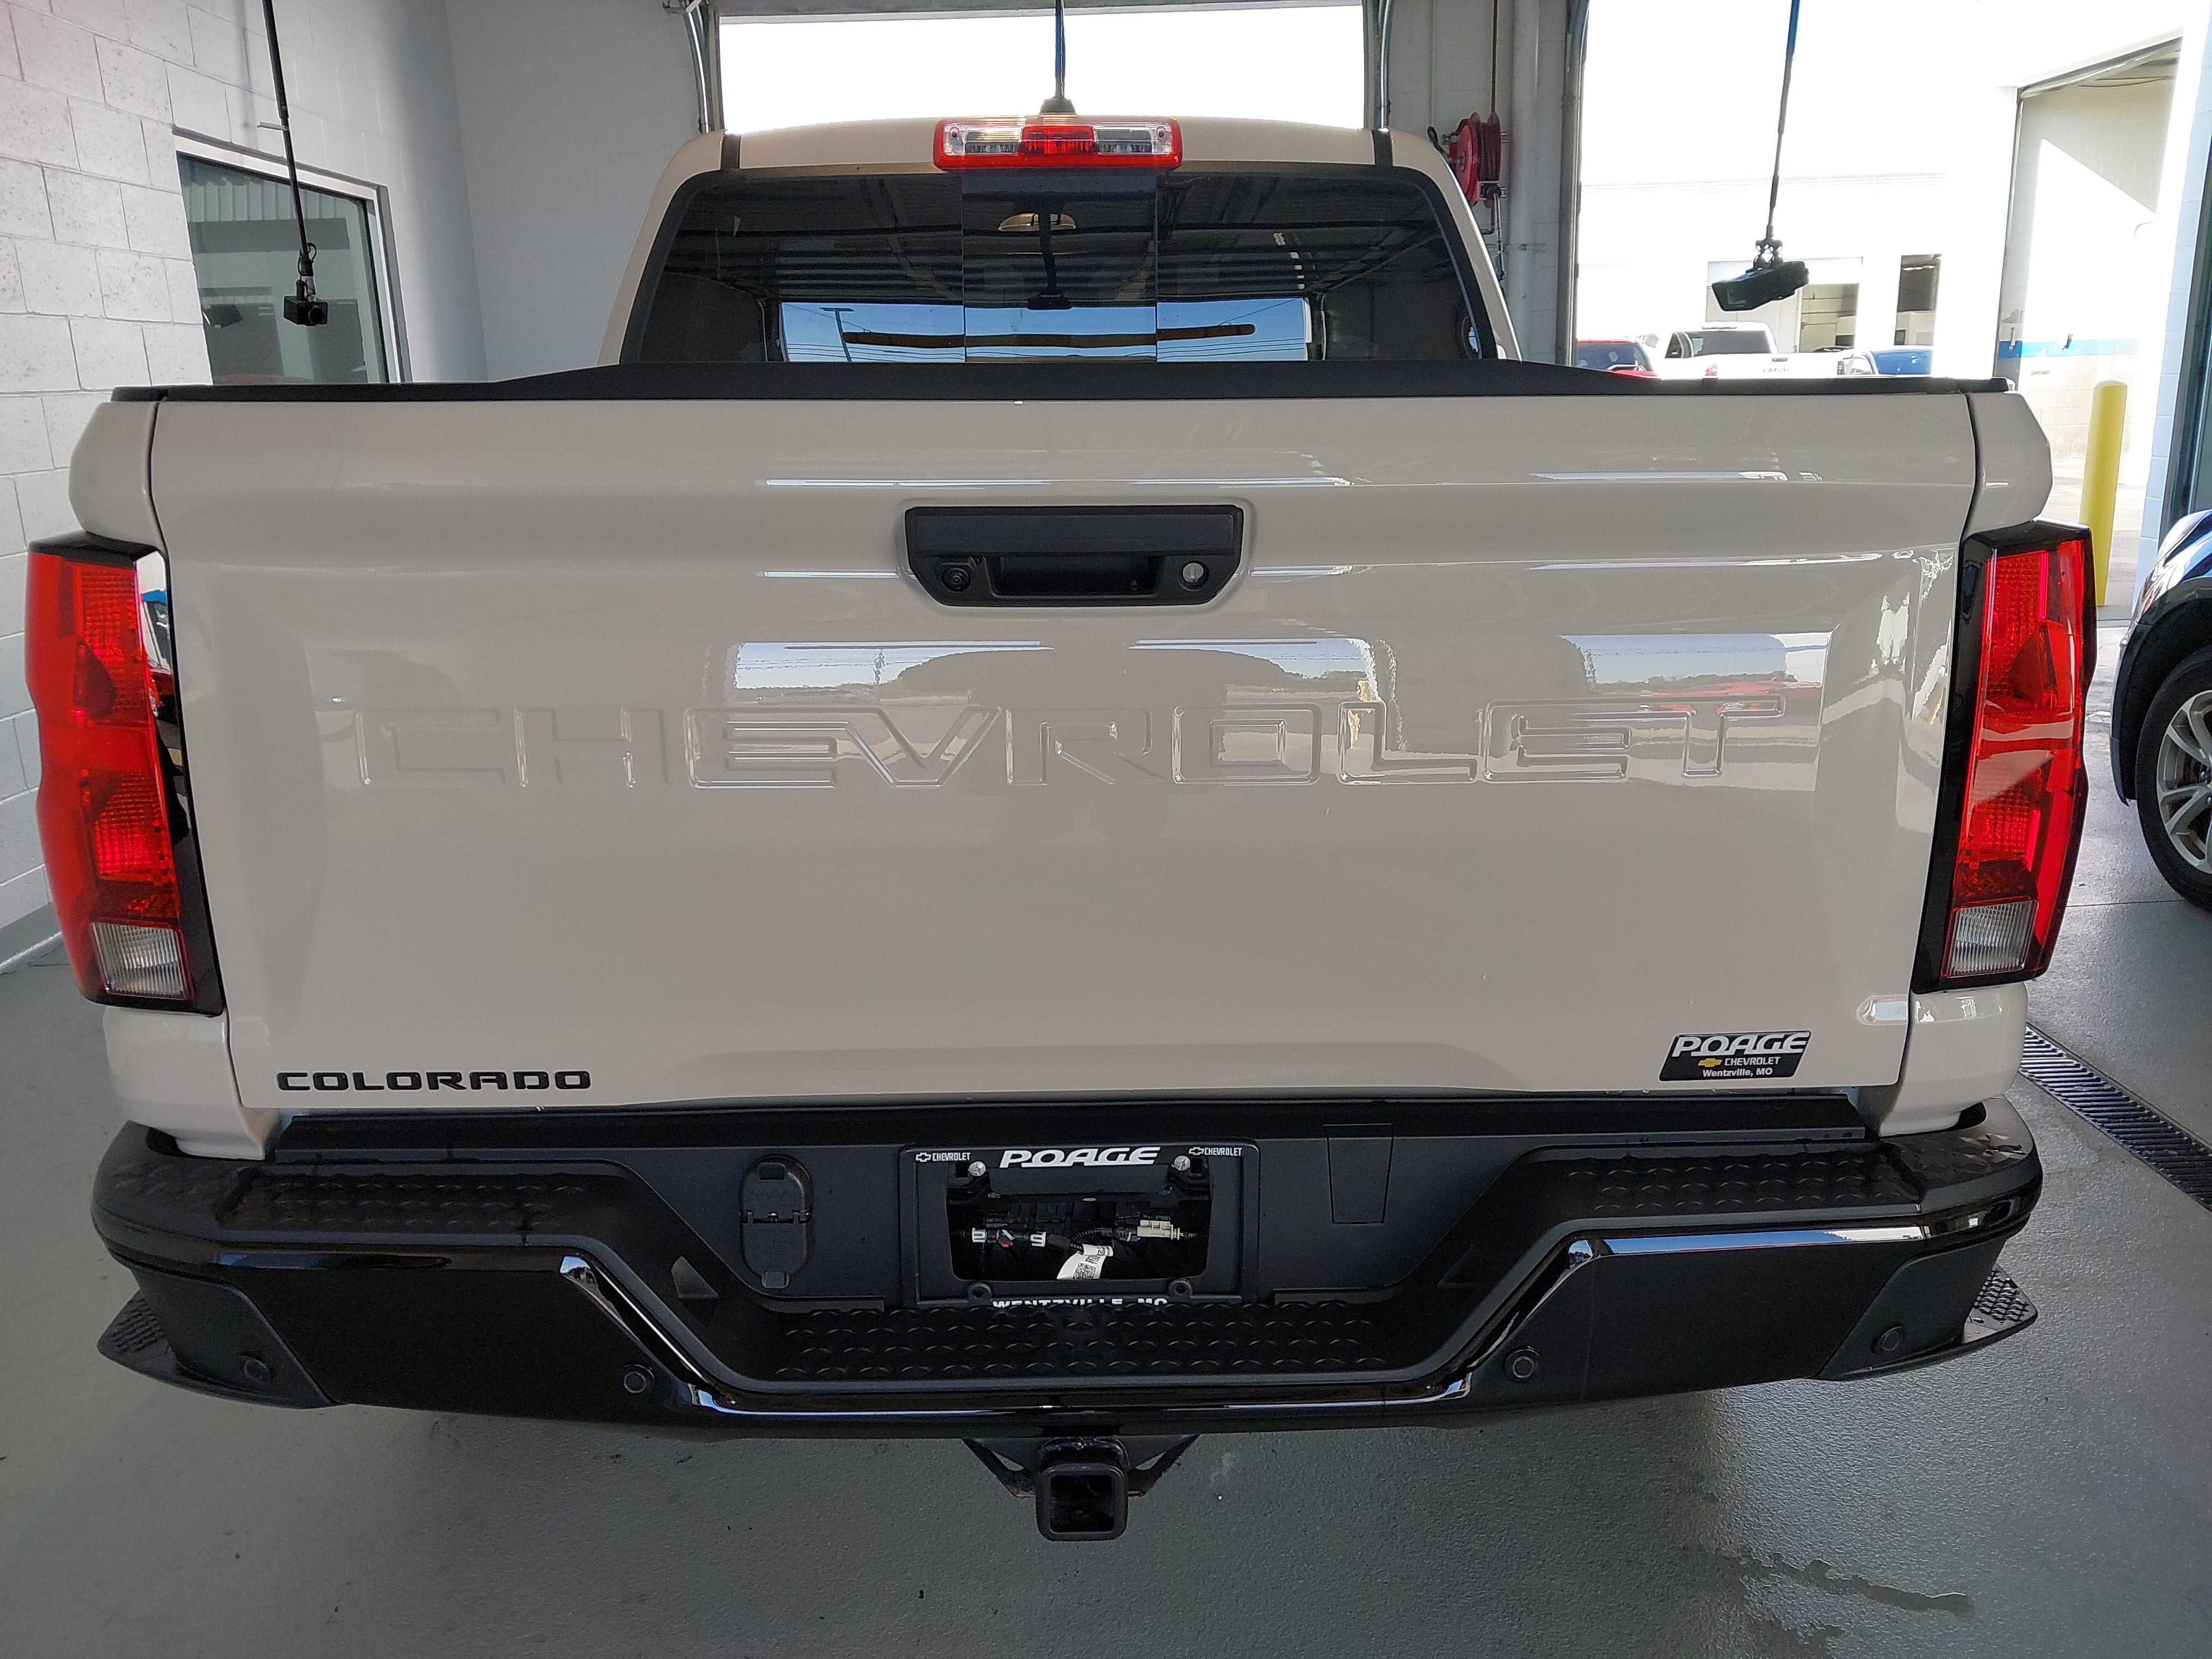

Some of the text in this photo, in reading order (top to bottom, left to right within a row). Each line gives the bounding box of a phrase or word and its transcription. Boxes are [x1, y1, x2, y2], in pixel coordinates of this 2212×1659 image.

[355, 696, 1786, 790] CHEVROLET
[1671, 1032, 1809, 1057] POAGE
[1725, 1057, 1781, 1066] CHEVROLET
[1703, 1069, 1753, 1077] Wentzville,
[276, 1071, 591, 1091] COLORADO
[933, 1152, 970, 1161] CHEVROLET
[999, 1147, 1160, 1168] POAGE
[1204, 1147, 1242, 1156] CHEVROLET
